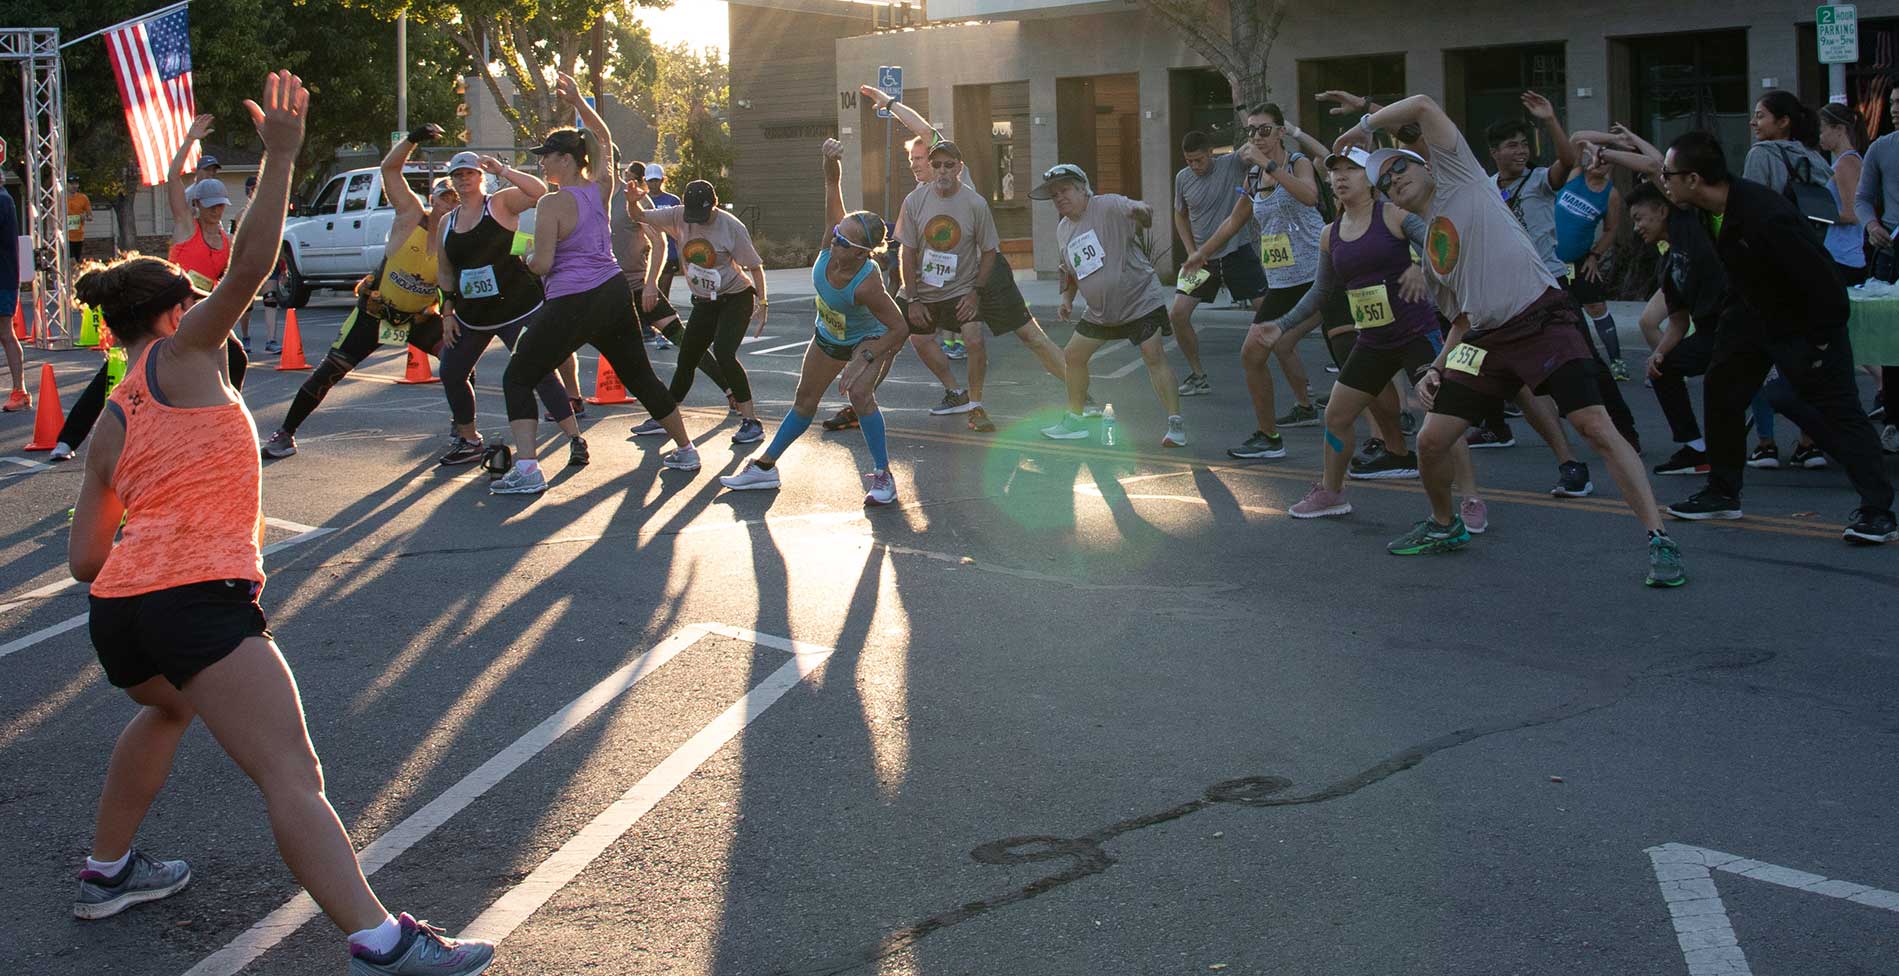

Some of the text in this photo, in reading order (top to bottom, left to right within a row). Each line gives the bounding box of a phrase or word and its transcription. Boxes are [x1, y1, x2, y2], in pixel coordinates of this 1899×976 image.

[1822, 10, 1854, 22] 2 HOUR
[1820, 24, 1855, 35] PARKING
[840, 90, 857, 110] 104
[1082, 244, 1096, 261] 50
[1269, 247, 1289, 263] 594
[473, 278, 493, 294] 503
[701, 278, 716, 291] 173
[1364, 302, 1385, 321] 567
